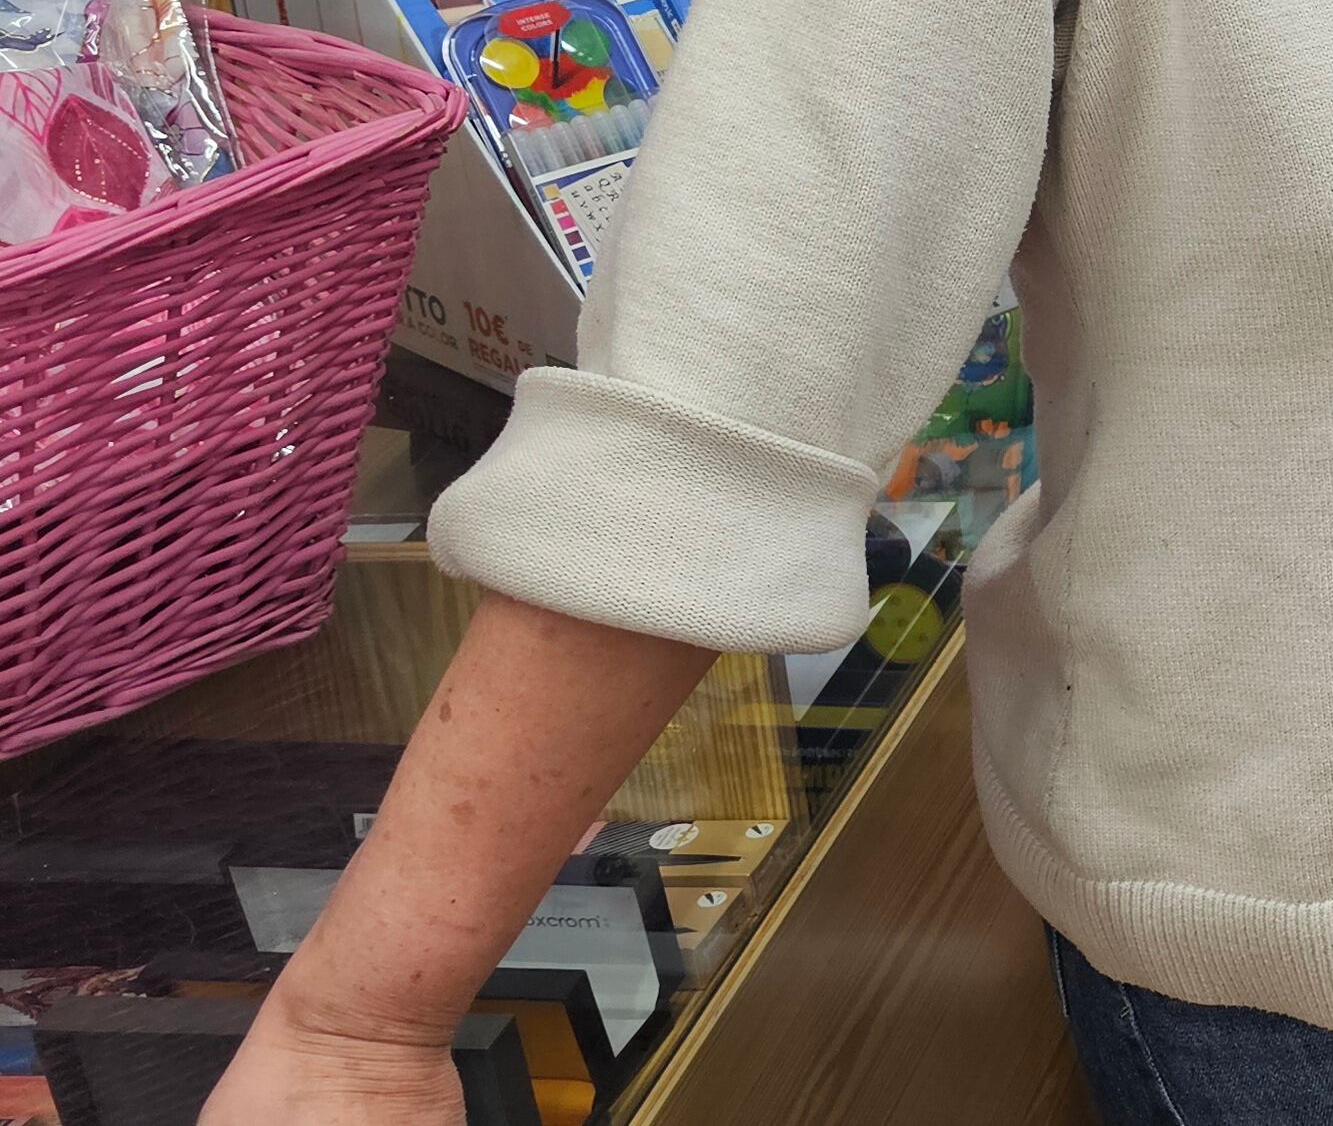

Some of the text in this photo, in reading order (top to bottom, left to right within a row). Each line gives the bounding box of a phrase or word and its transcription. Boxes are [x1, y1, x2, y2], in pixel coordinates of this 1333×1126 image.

[516, 12, 551, 26] INTENSE
[520, 19, 553, 32] COLORS
[468, 338, 533, 375] REGAL
